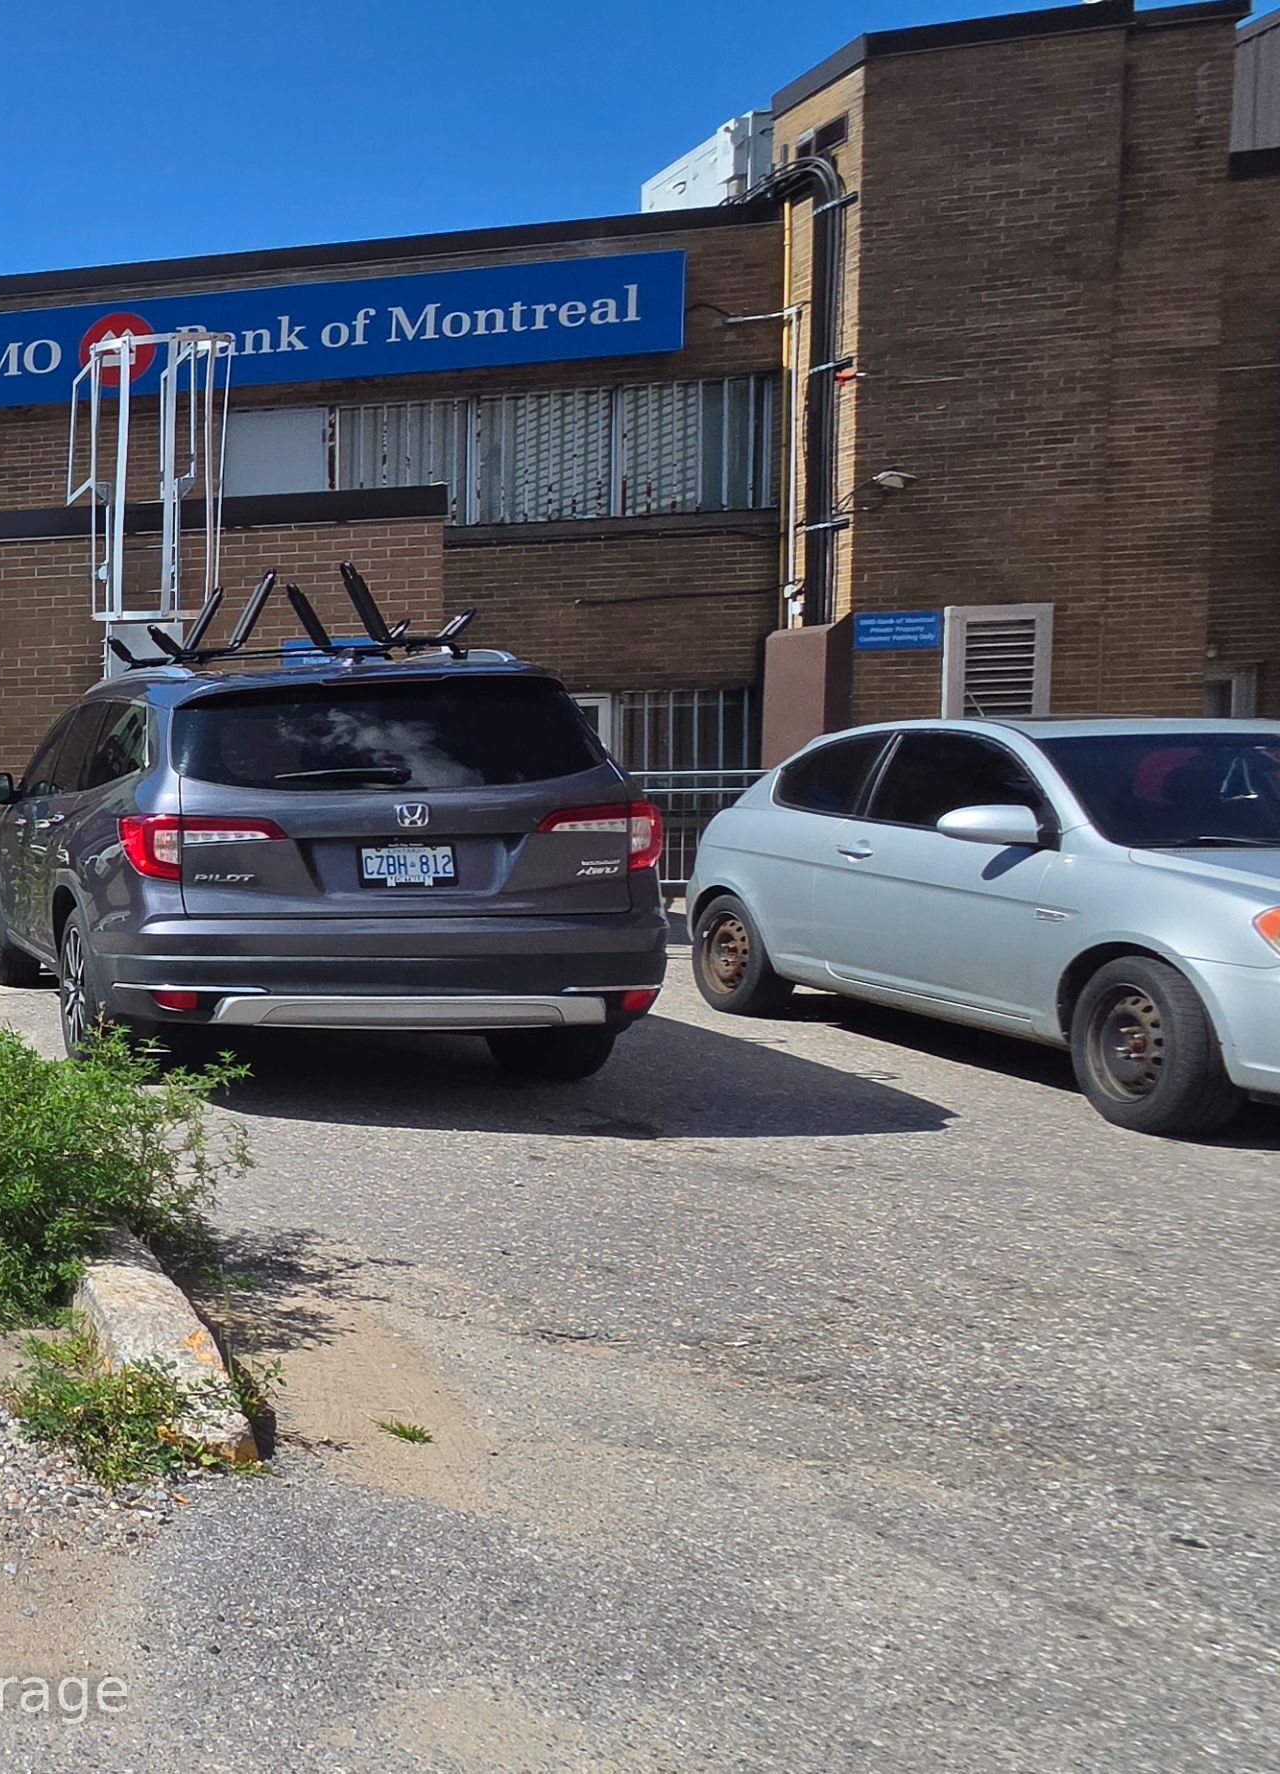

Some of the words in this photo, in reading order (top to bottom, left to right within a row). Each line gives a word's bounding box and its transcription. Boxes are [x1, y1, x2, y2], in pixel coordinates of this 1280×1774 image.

[321, 308, 376, 348] of
[386, 283, 641, 343] Montreal
[194, 873, 255, 882] PILOT
